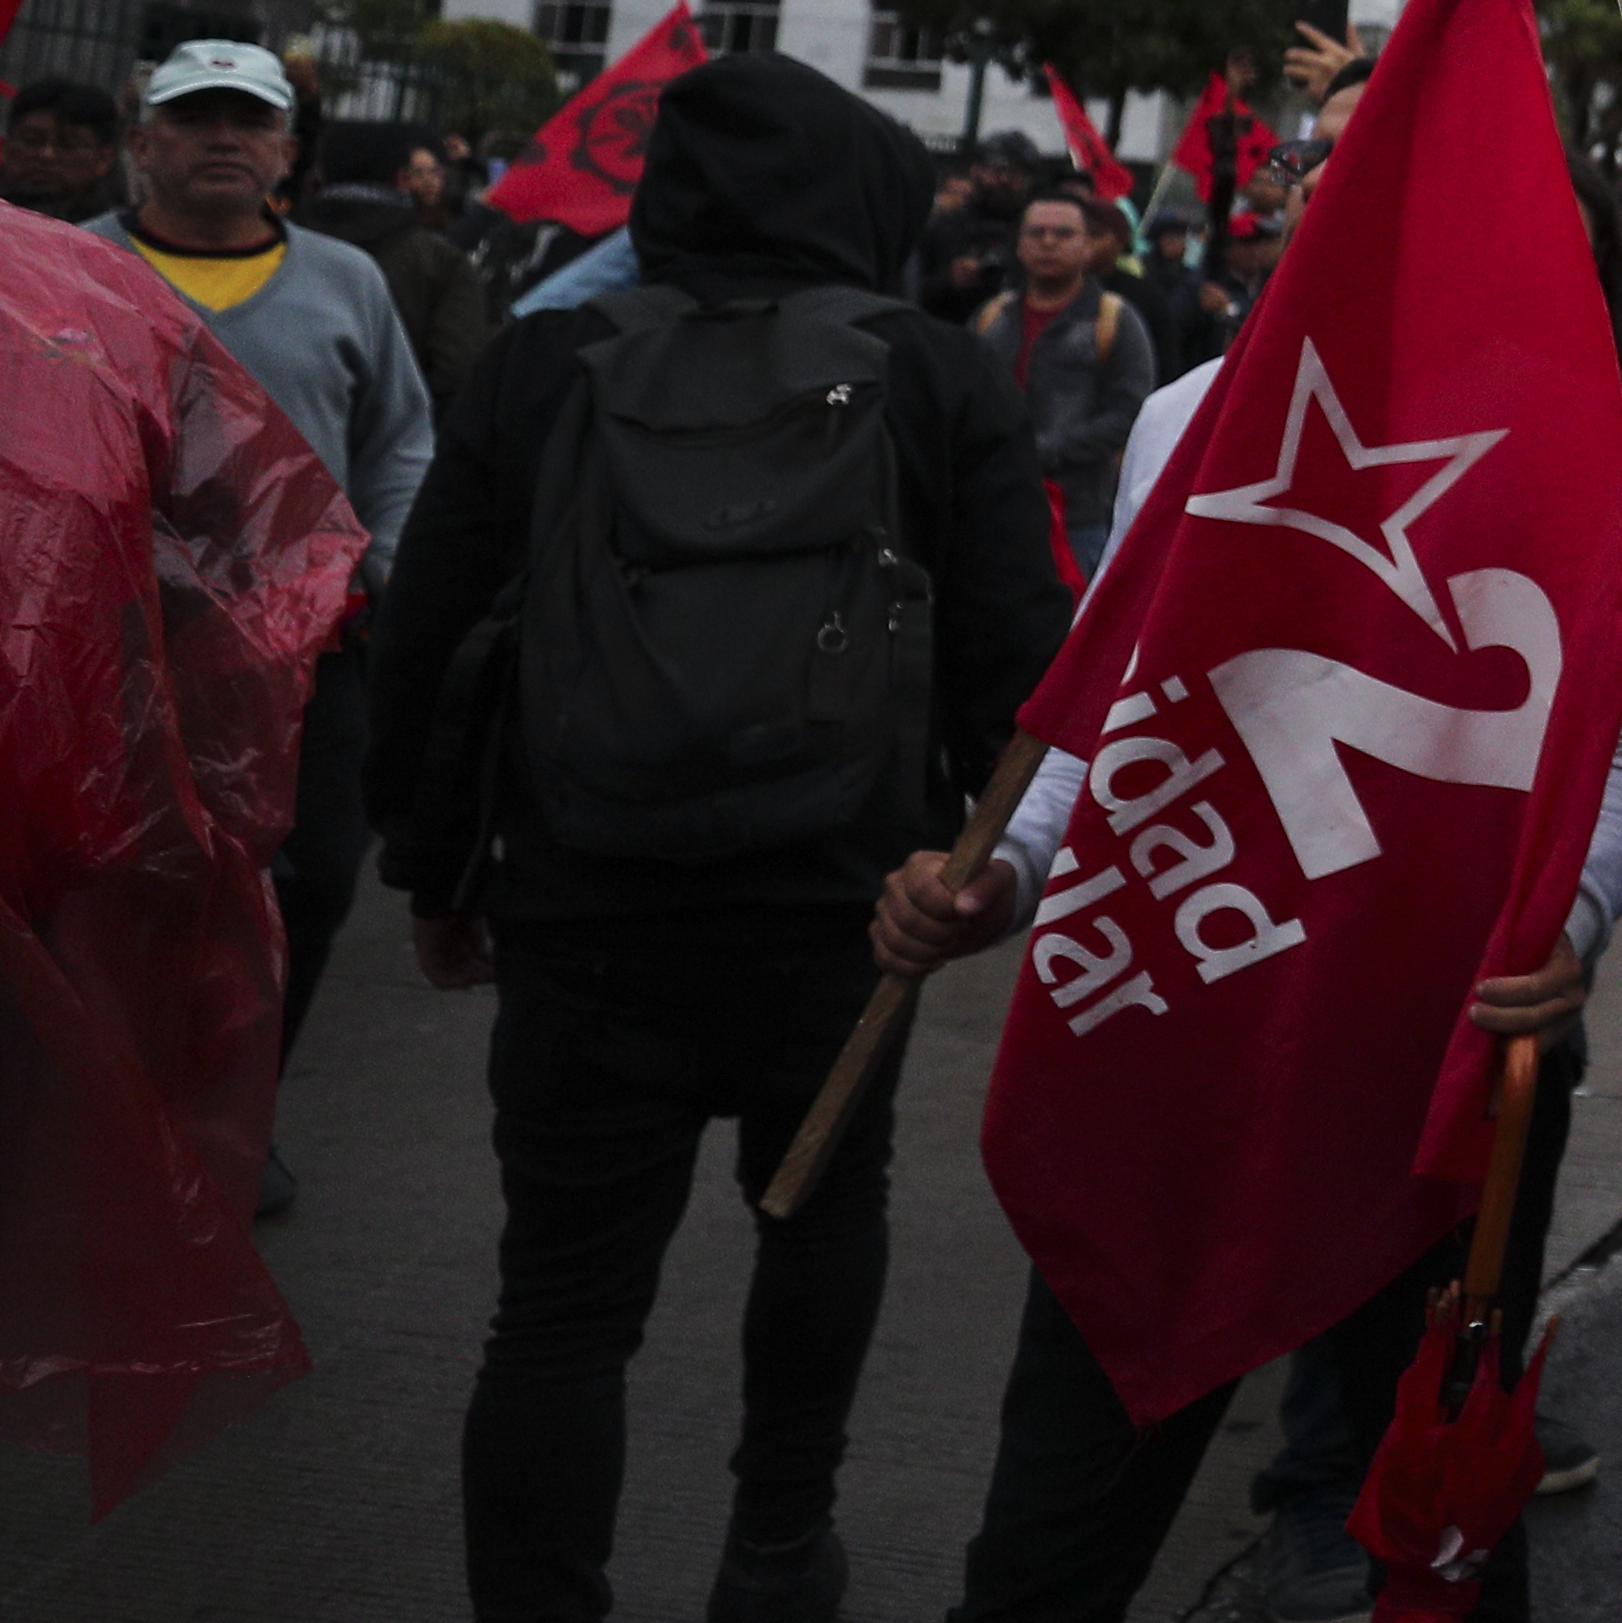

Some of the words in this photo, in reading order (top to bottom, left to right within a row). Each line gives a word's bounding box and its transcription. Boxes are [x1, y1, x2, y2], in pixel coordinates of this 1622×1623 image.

[1090, 642, 1307, 985] idad
[1207, 568, 1562, 880] 2
[1032, 847, 1169, 1037] lar
